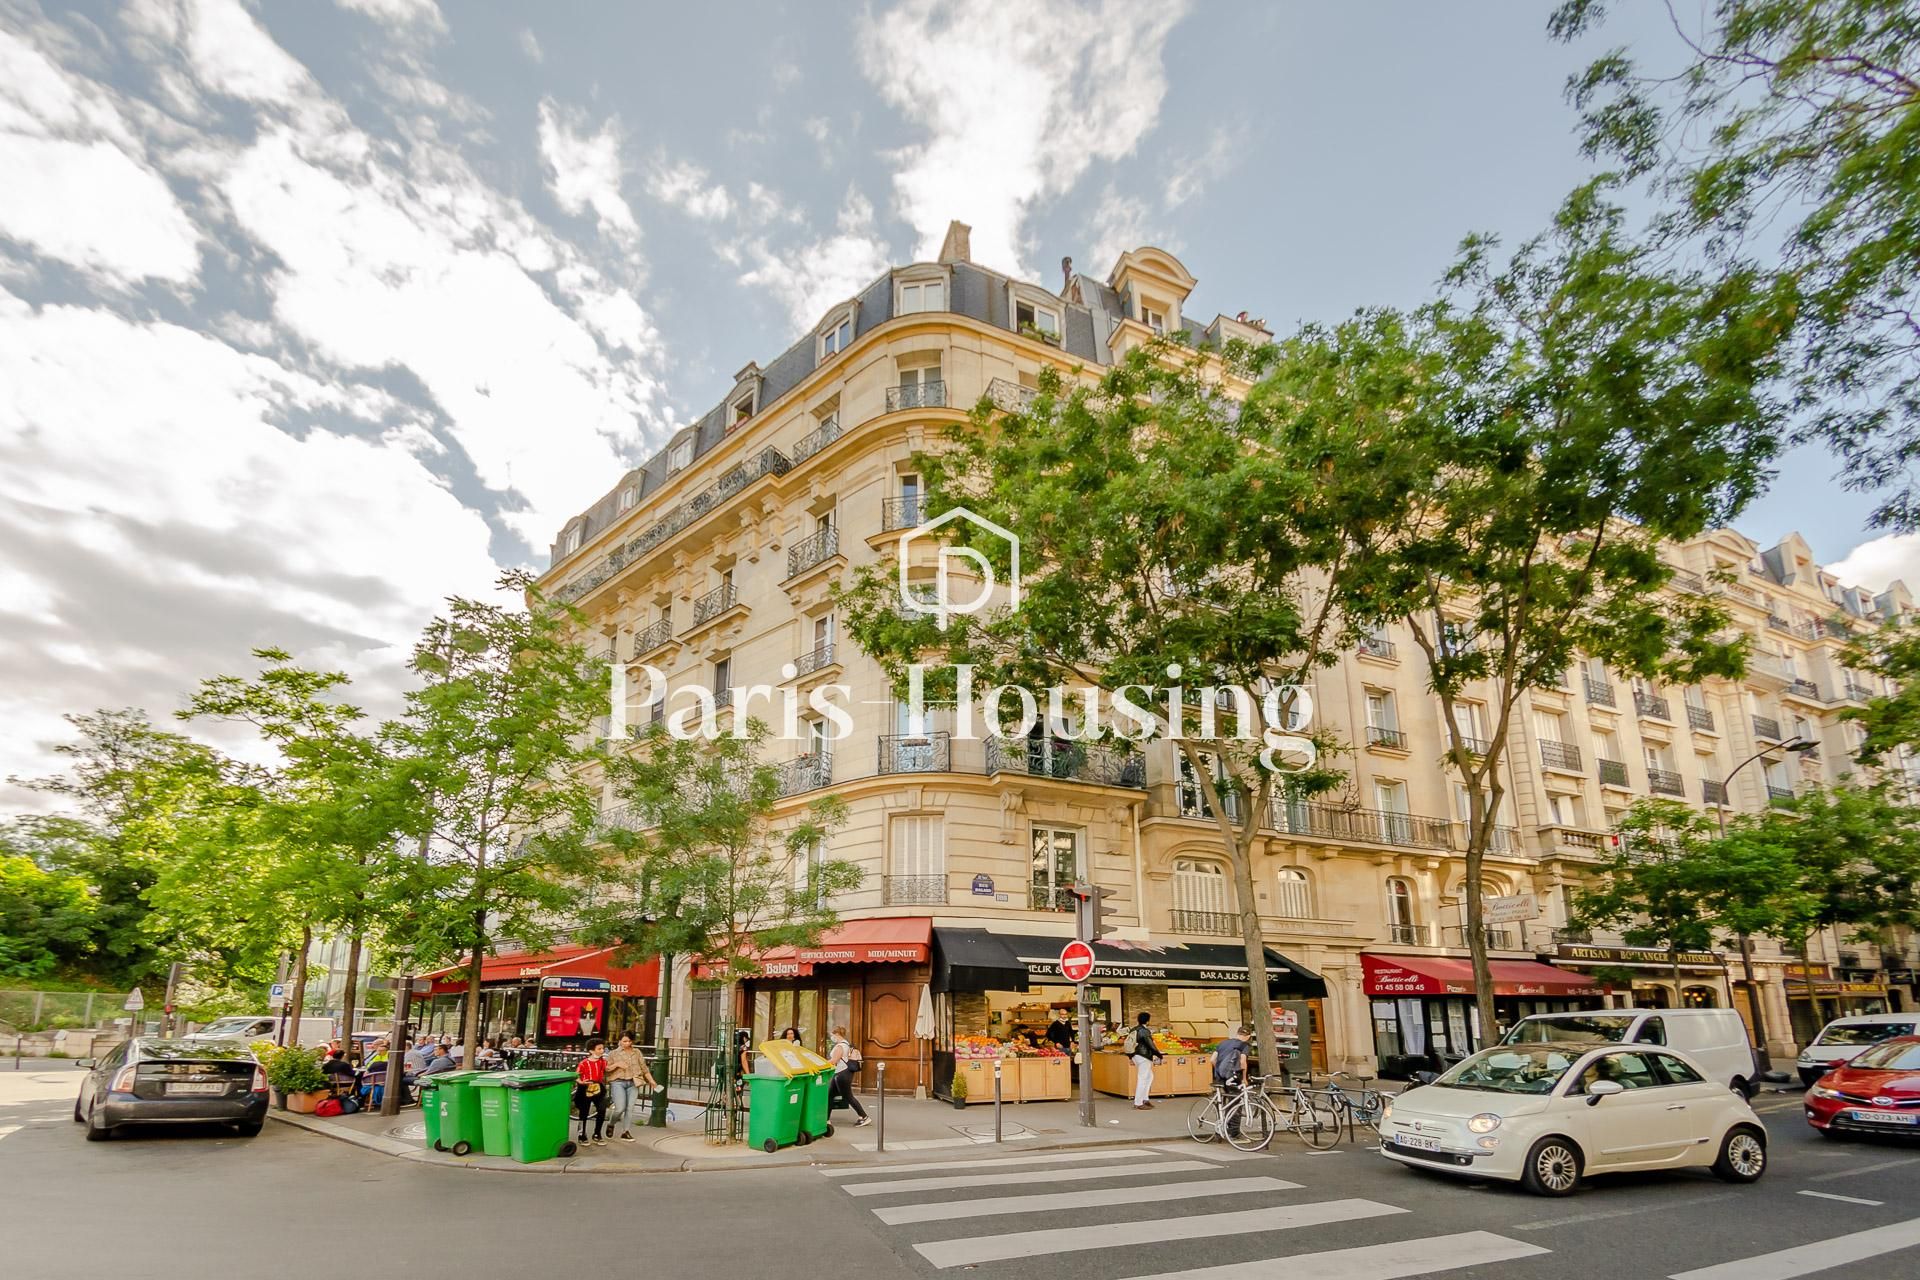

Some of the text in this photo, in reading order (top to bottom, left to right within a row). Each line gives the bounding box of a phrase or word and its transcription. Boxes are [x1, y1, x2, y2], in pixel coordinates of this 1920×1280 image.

[800, 950, 917, 959] SERVICE CONTINU MIDI/MINUIT
[1571, 947, 1610, 959] ARTISAN
[765, 962, 799, 975] Balard
[1113, 967, 1127, 976] DU
[1127, 968, 1166, 977] TERROIR
[1200, 971, 1216, 980] BAR
[1224, 972, 1239, 980] JUS
